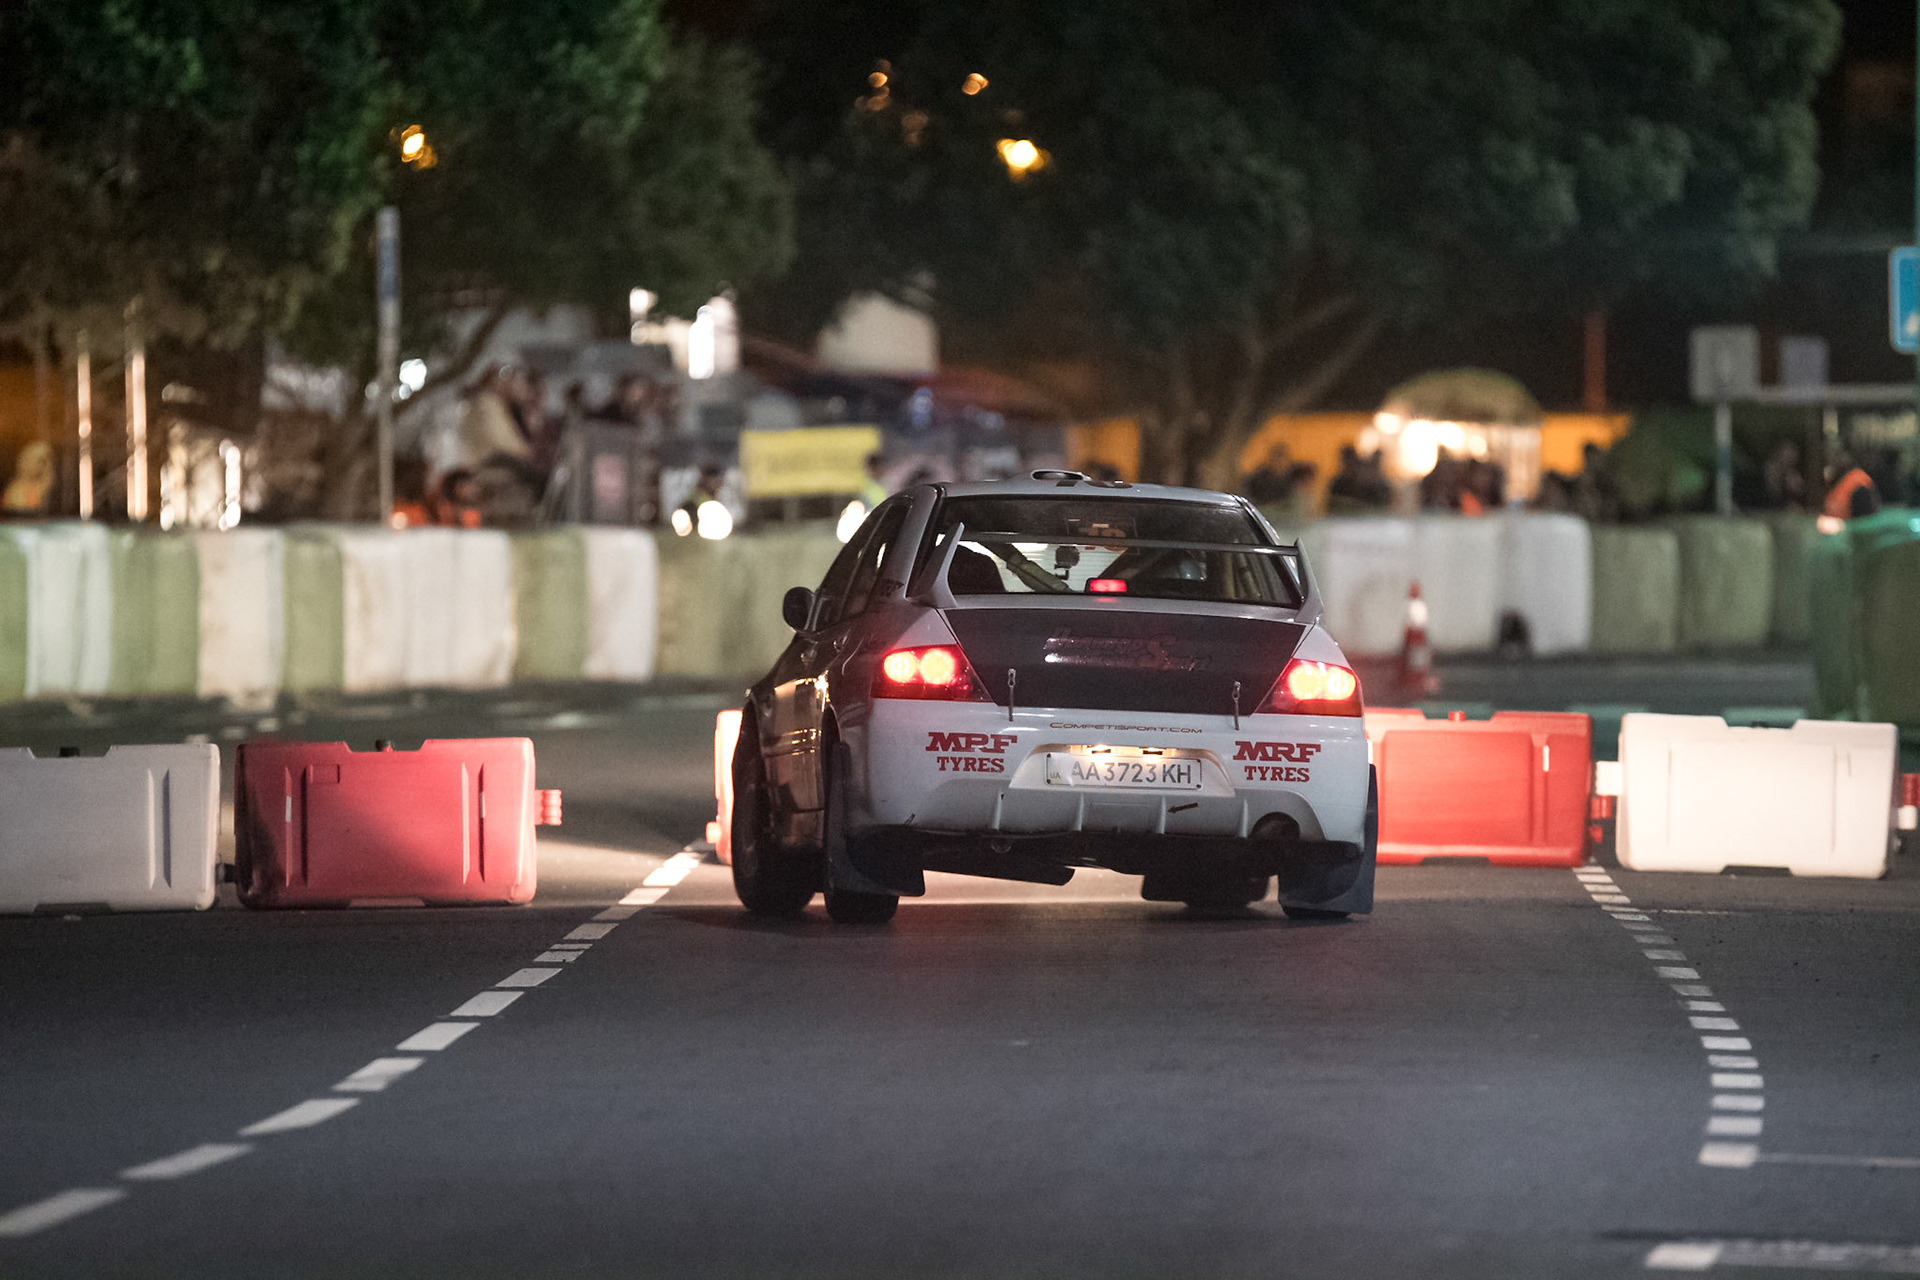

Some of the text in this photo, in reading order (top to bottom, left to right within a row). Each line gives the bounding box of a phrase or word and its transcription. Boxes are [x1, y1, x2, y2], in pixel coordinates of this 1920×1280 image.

[1050, 721, 1203, 734] COMPETISPORT.COM
[925, 732, 1018, 753] MRF
[1232, 740, 1321, 763] MRF
[937, 756, 1005, 773] TYRES
[1244, 765, 1310, 783] TYRES
